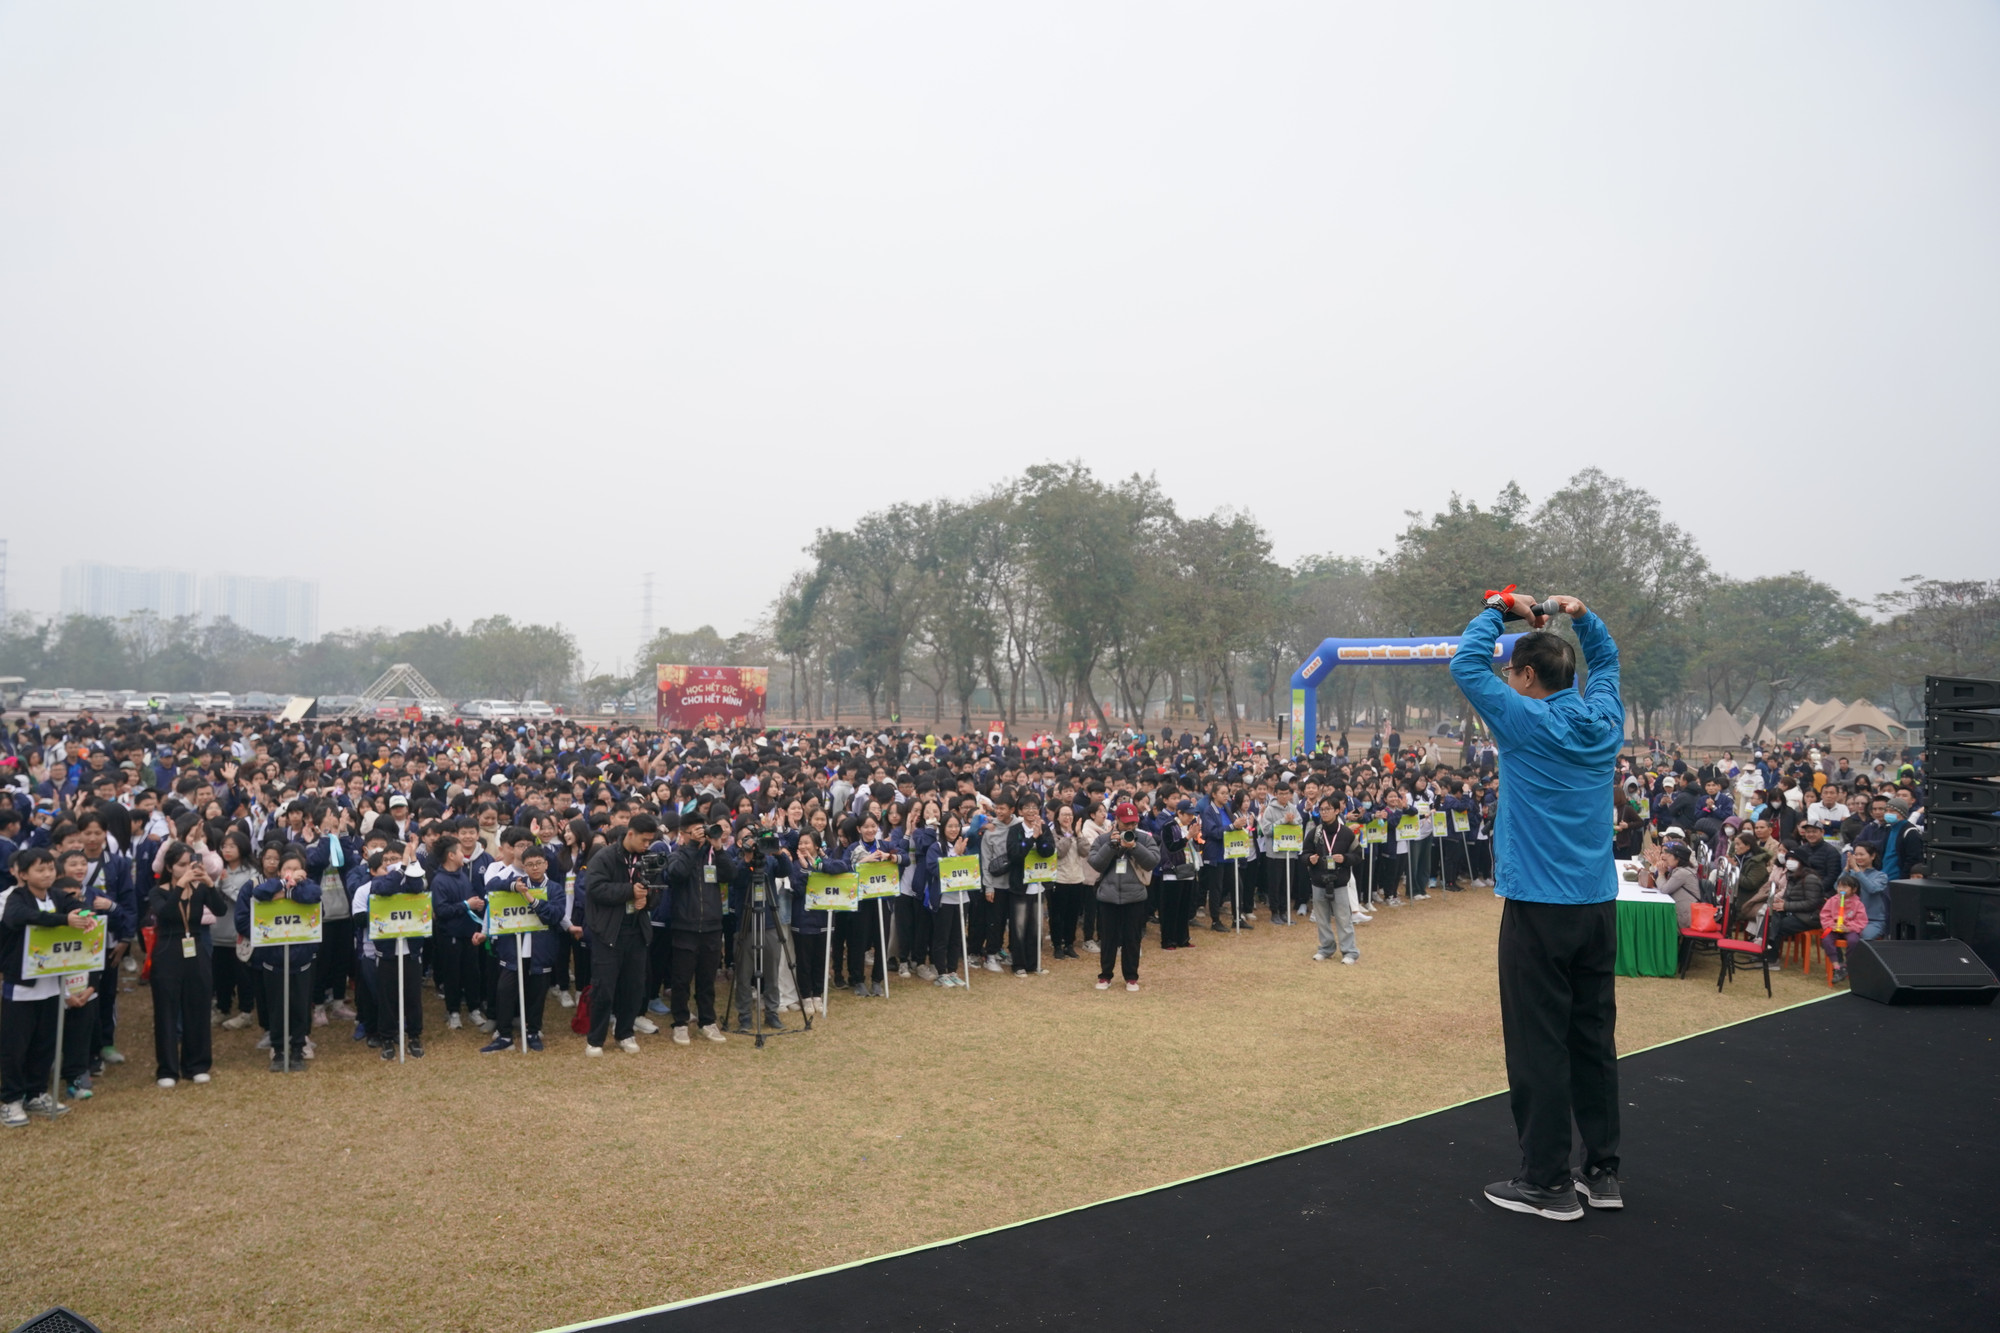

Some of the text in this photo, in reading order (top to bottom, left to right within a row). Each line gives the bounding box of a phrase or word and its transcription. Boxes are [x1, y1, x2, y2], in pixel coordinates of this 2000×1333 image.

[1303, 658, 1321, 677] START
[686, 681, 738, 696] HỌC HẾT SỨC
[681, 693, 743, 707] CHƠI HẾT MÌNH
[869, 875, 887, 884] 8V5
[951, 869, 969, 878] 8V4
[825, 887, 840, 896] 6N
[274, 914, 302, 926] 6V2
[390, 911, 412, 921] 6V1
[52, 940, 83, 954] 6V3
